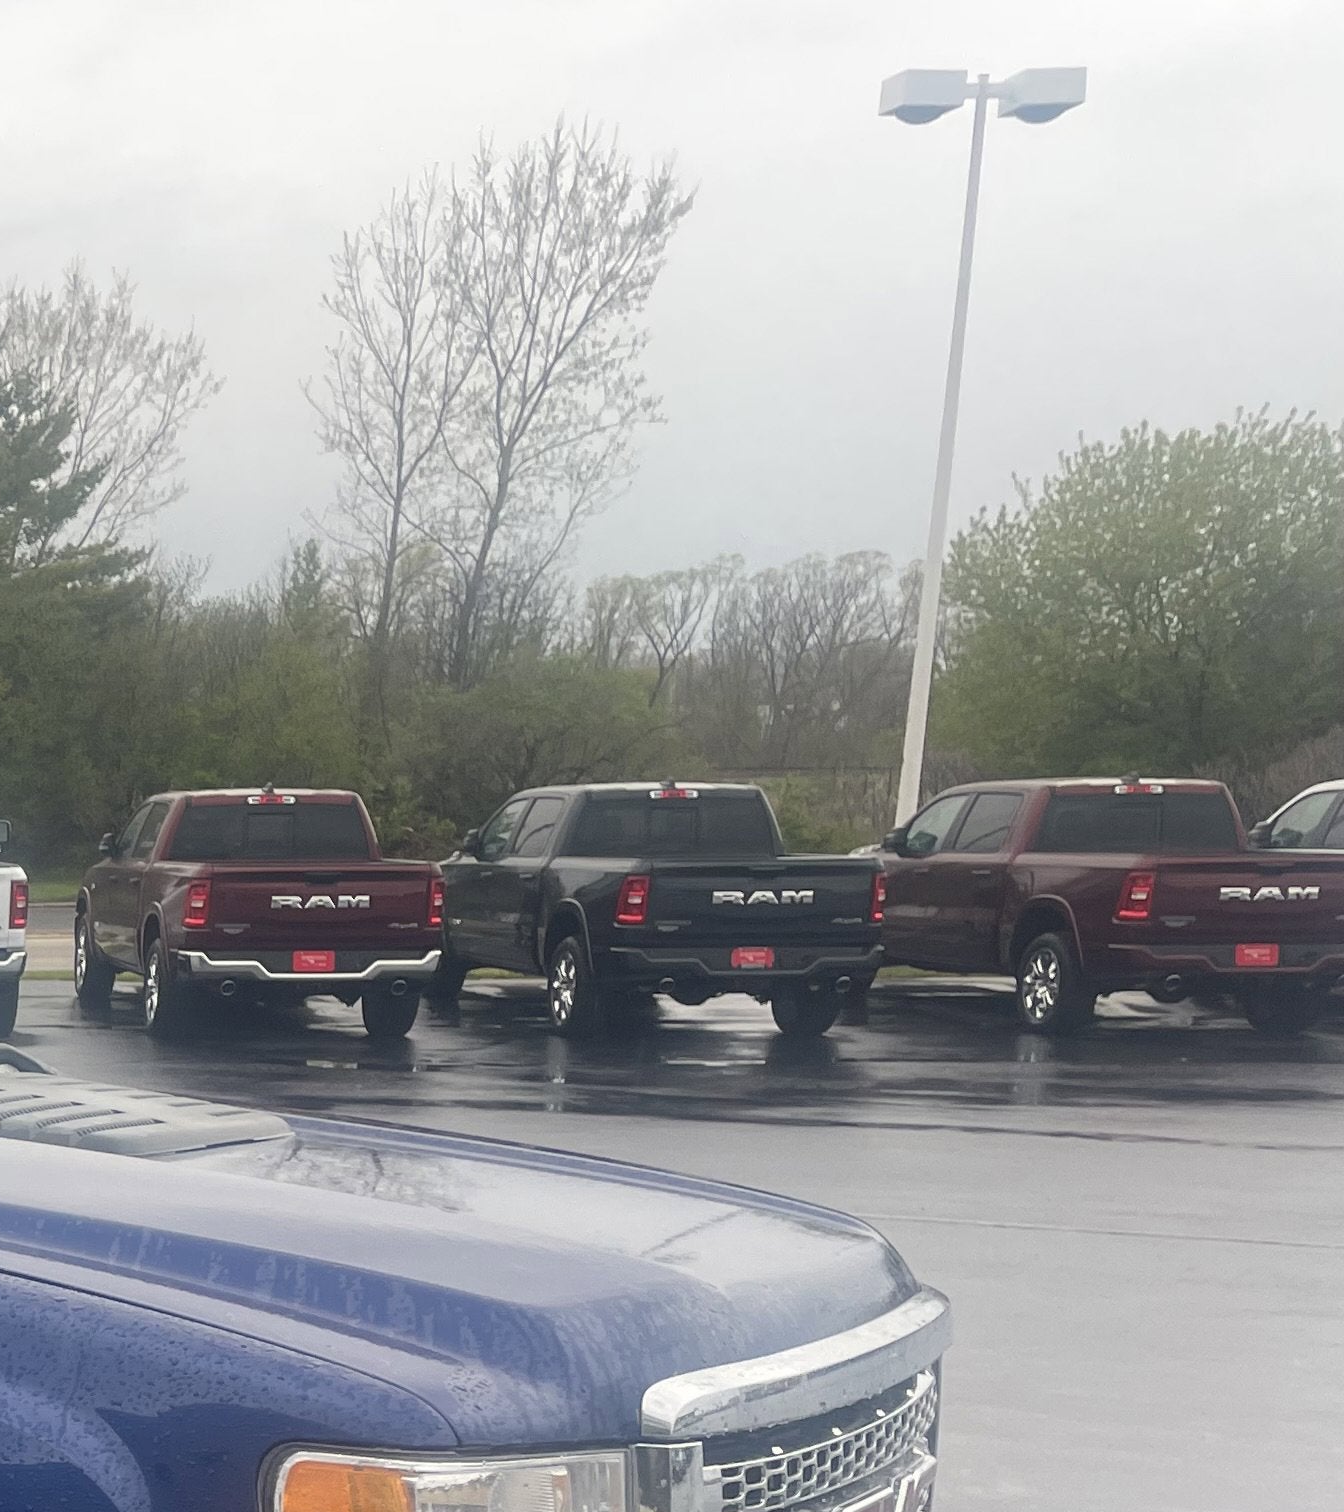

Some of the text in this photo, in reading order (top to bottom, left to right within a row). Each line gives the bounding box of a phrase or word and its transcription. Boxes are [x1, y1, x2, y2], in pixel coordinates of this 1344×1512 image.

[712, 890, 814, 905] RAM
[1219, 886, 1321, 901] RAM
[270, 895, 370, 909] RAM
